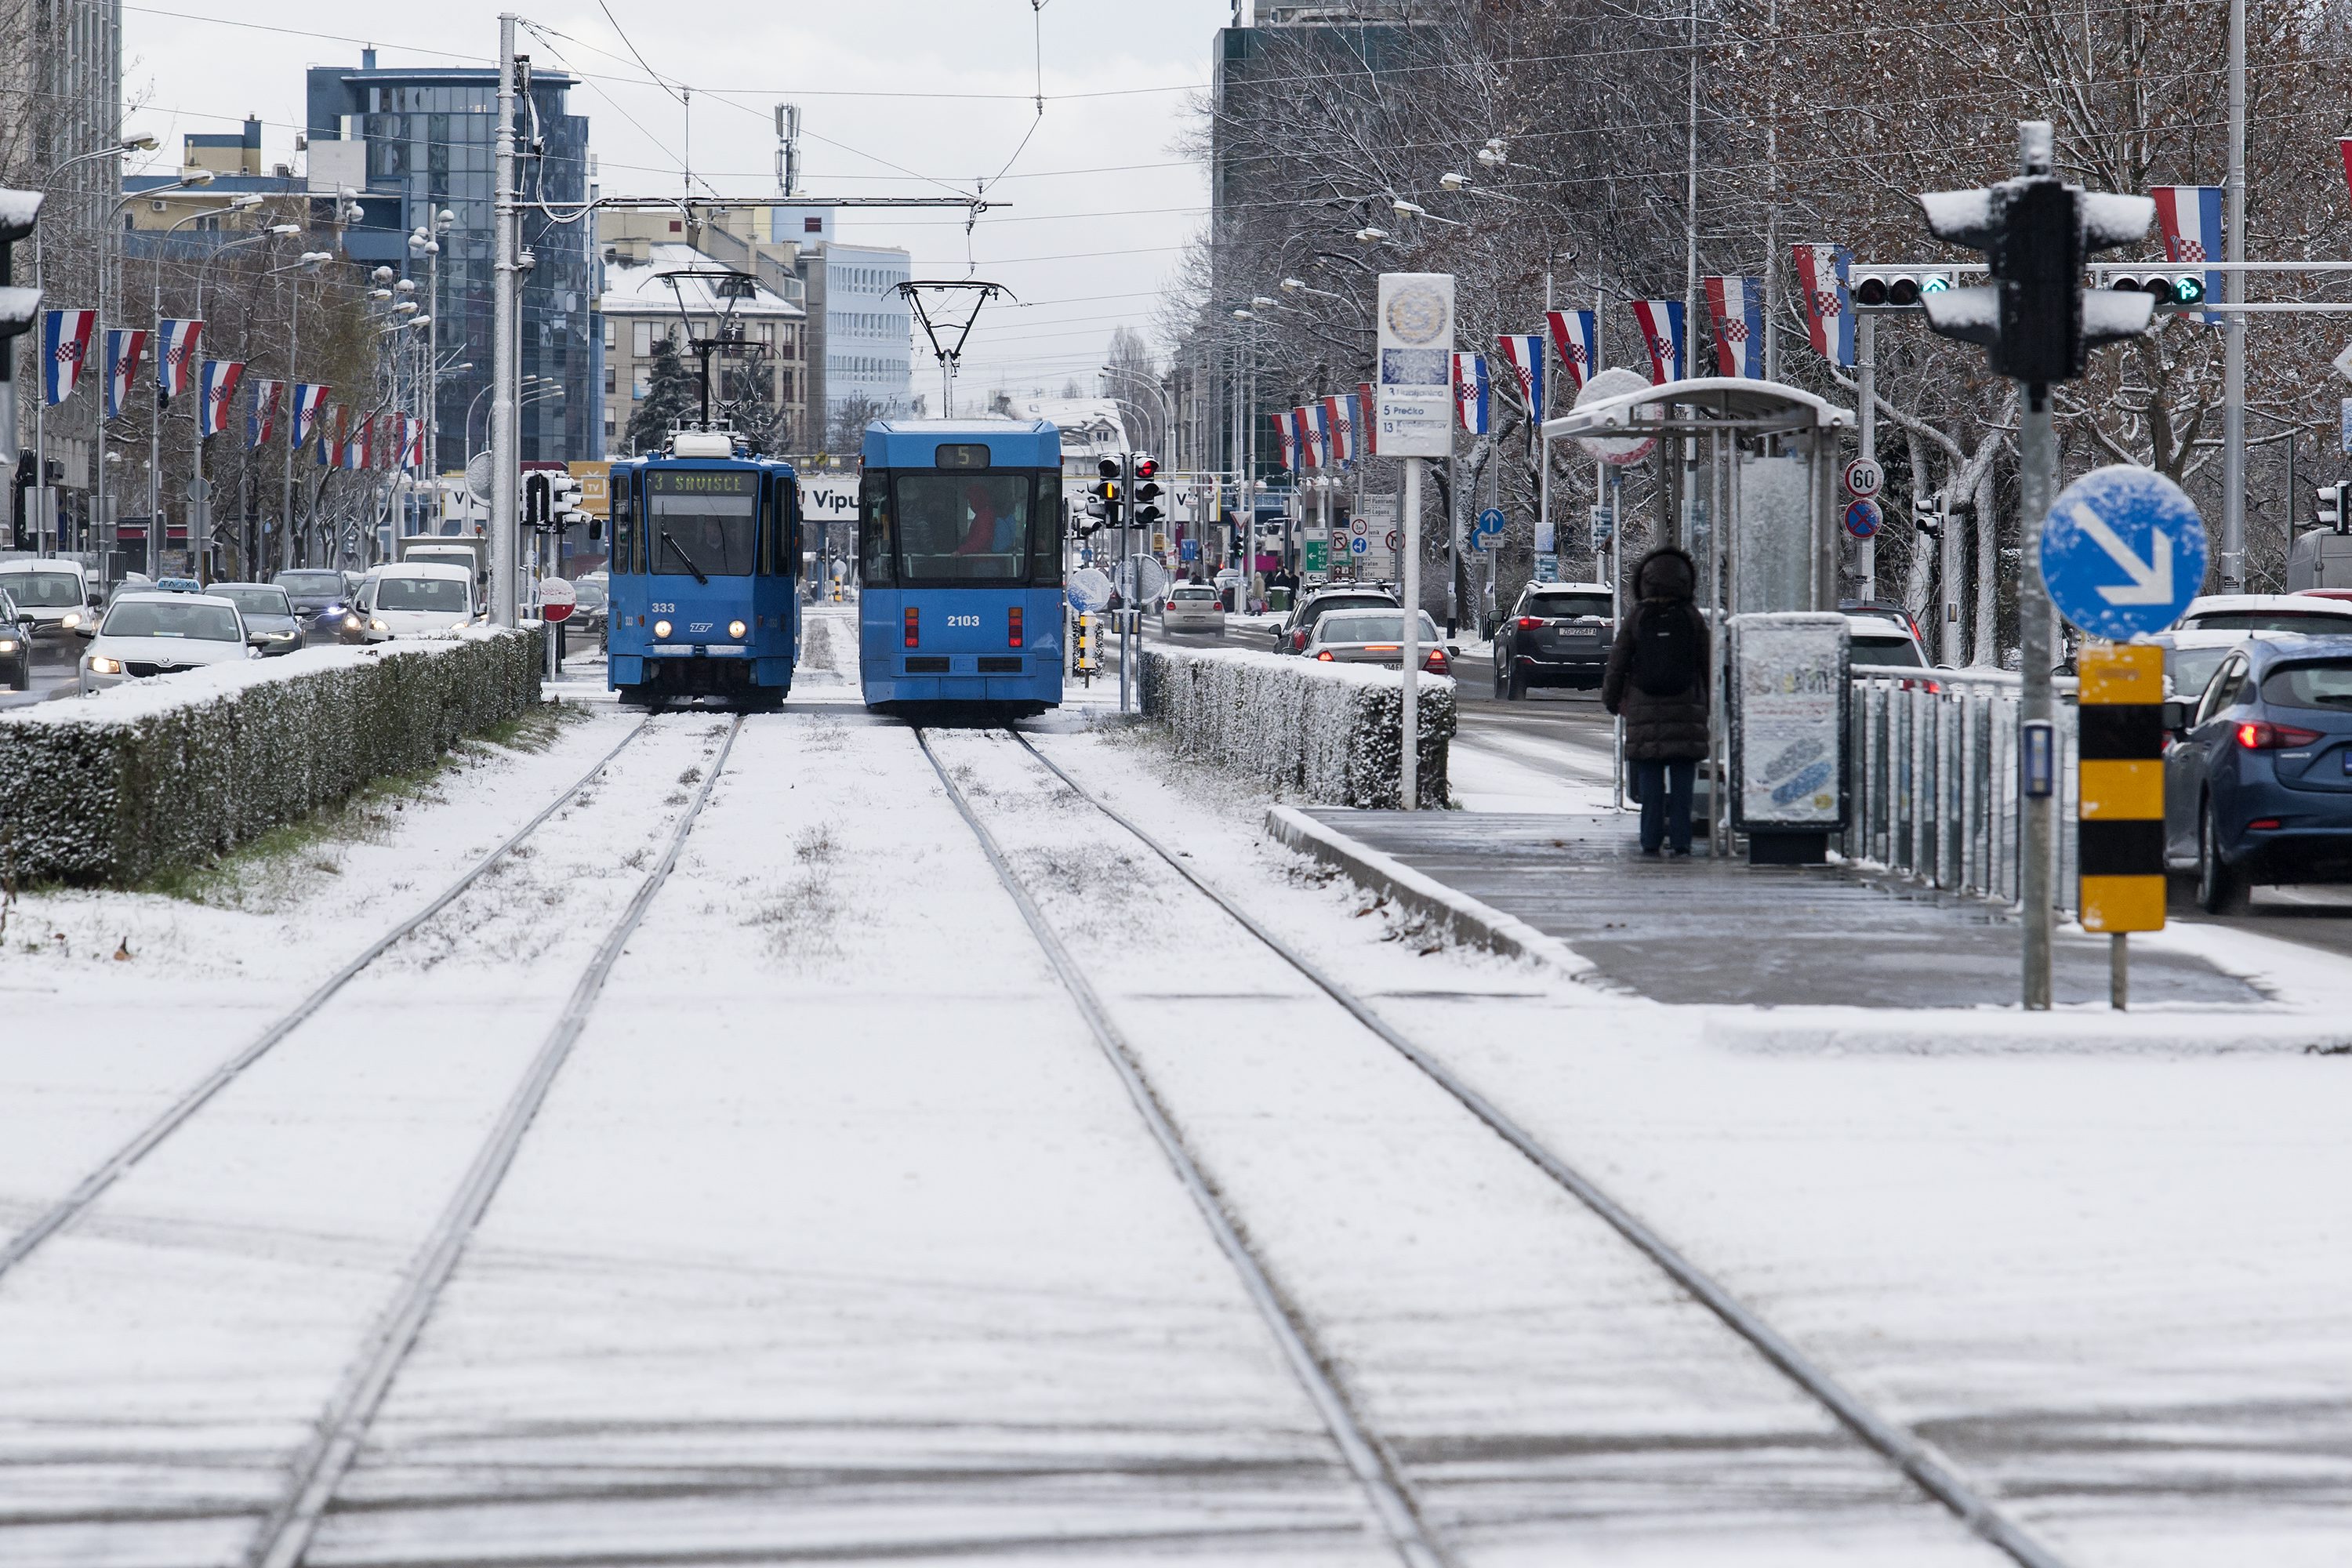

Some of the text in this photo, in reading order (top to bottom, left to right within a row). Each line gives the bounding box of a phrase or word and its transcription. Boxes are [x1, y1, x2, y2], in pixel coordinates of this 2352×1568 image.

[1384, 405, 1425, 416] 5 Prečko
[1384, 423, 1393, 433] 13
[958, 445, 970, 465] 5
[655, 473, 663, 491] 3
[1853, 469, 1875, 488] 60
[586, 483, 600, 492] TV
[652, 603, 675, 613] 333
[947, 615, 980, 626] 2103
[690, 623, 713, 633] ZET
